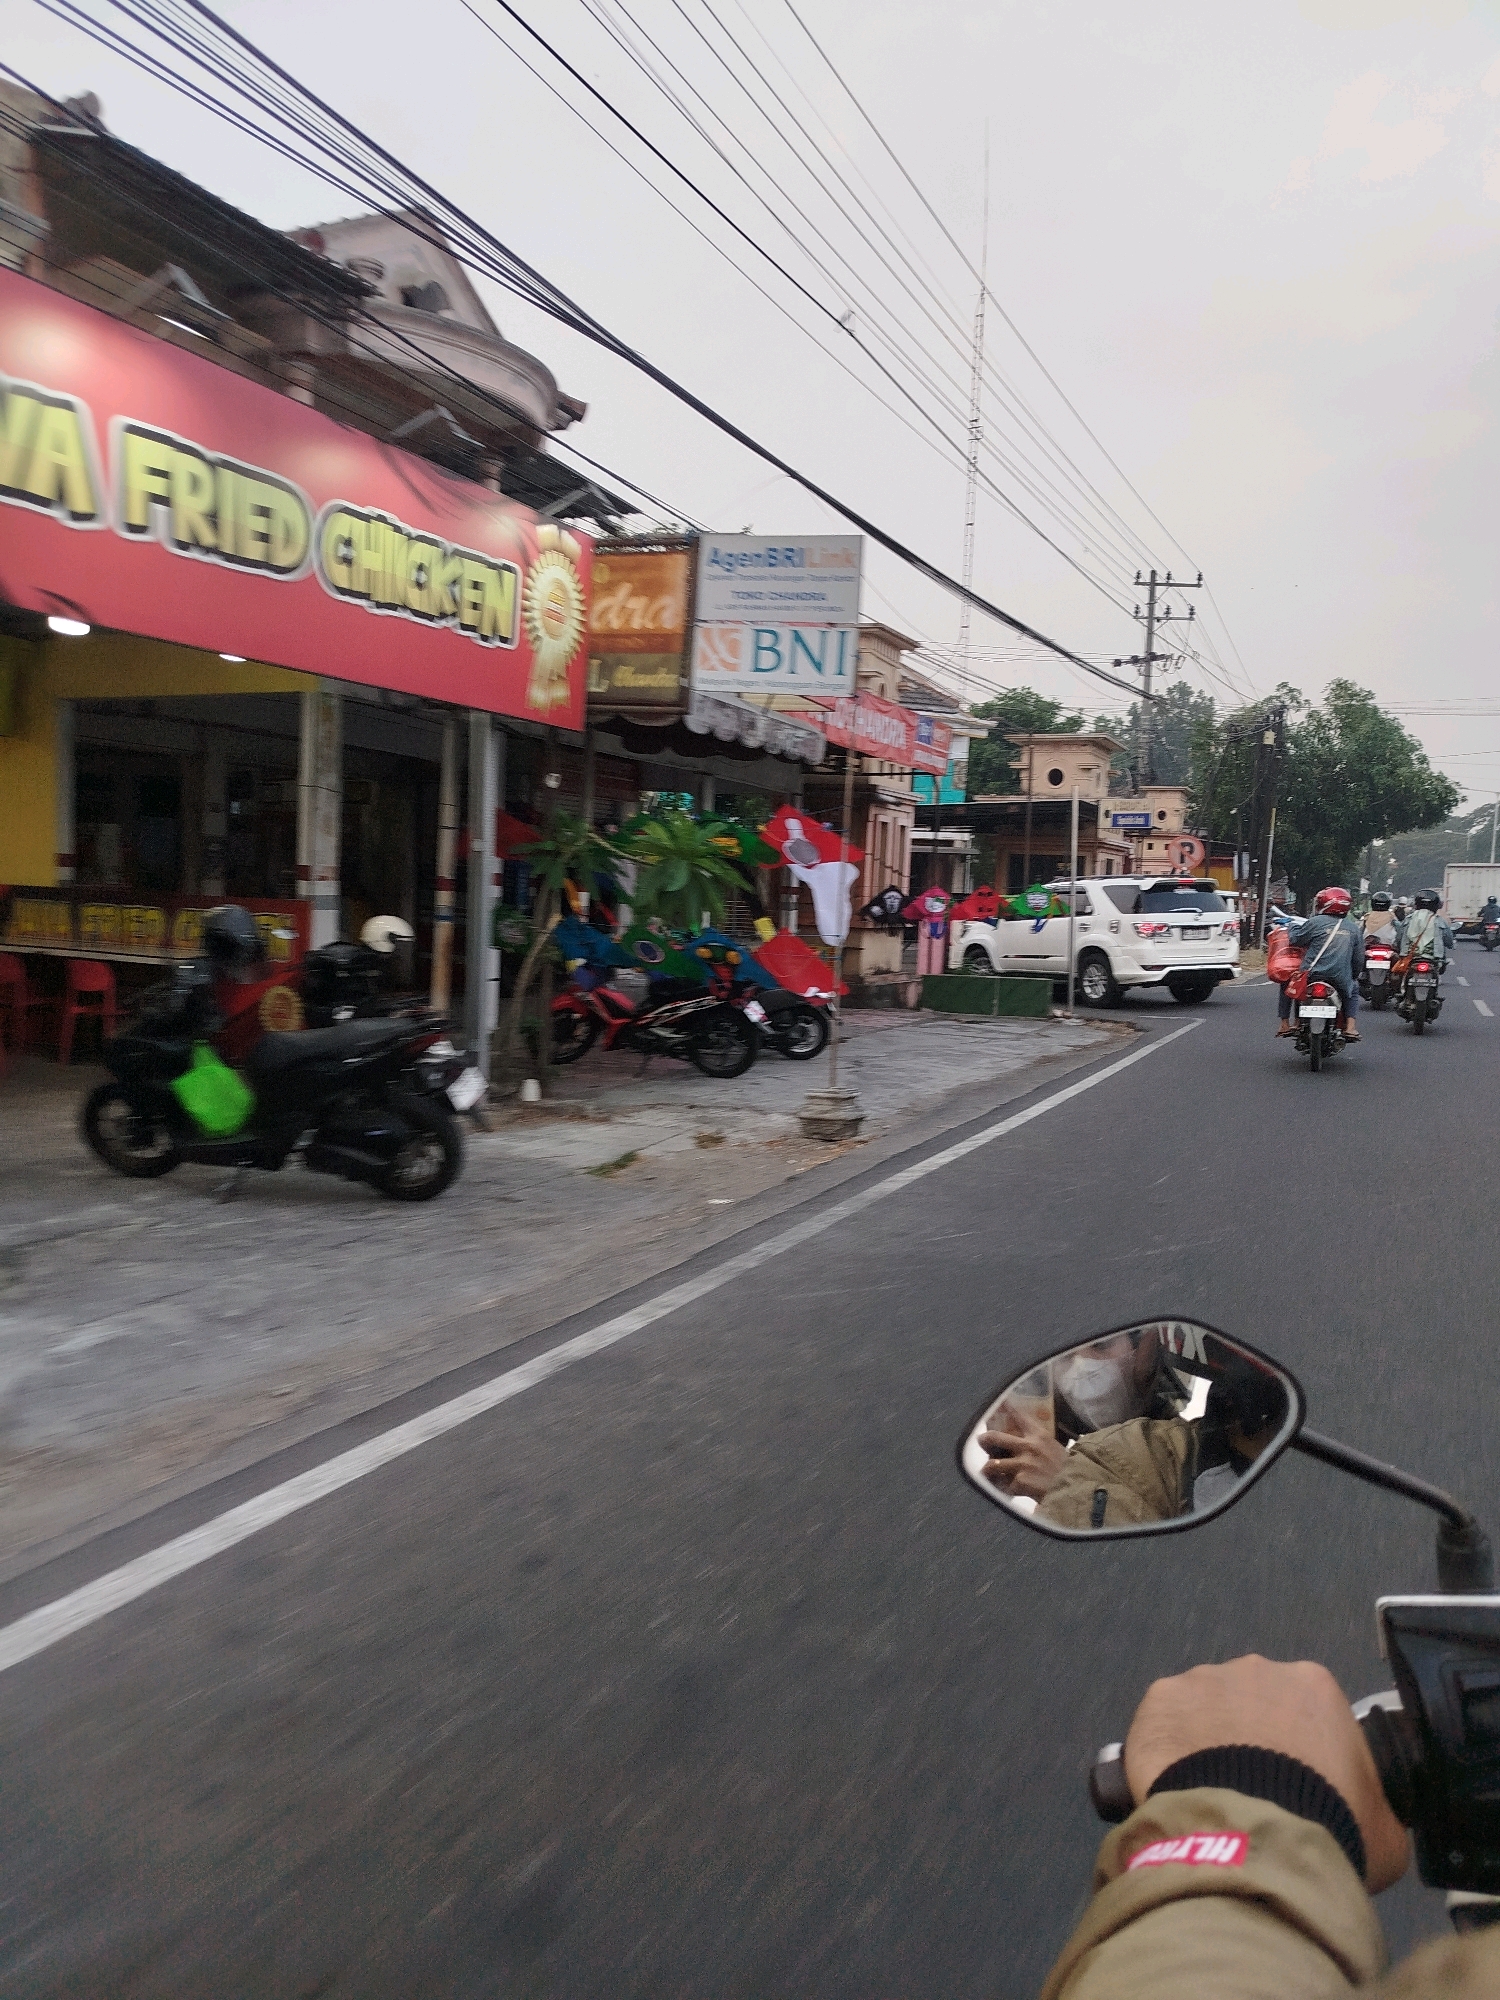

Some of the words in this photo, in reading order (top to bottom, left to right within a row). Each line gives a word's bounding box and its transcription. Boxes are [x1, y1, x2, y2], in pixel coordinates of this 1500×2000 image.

[112, 418, 312, 579] FRIED
[318, 502, 520, 647] CHICKEN
[750, 628, 851, 676] BNI
[1180, 841, 1195, 864] P
